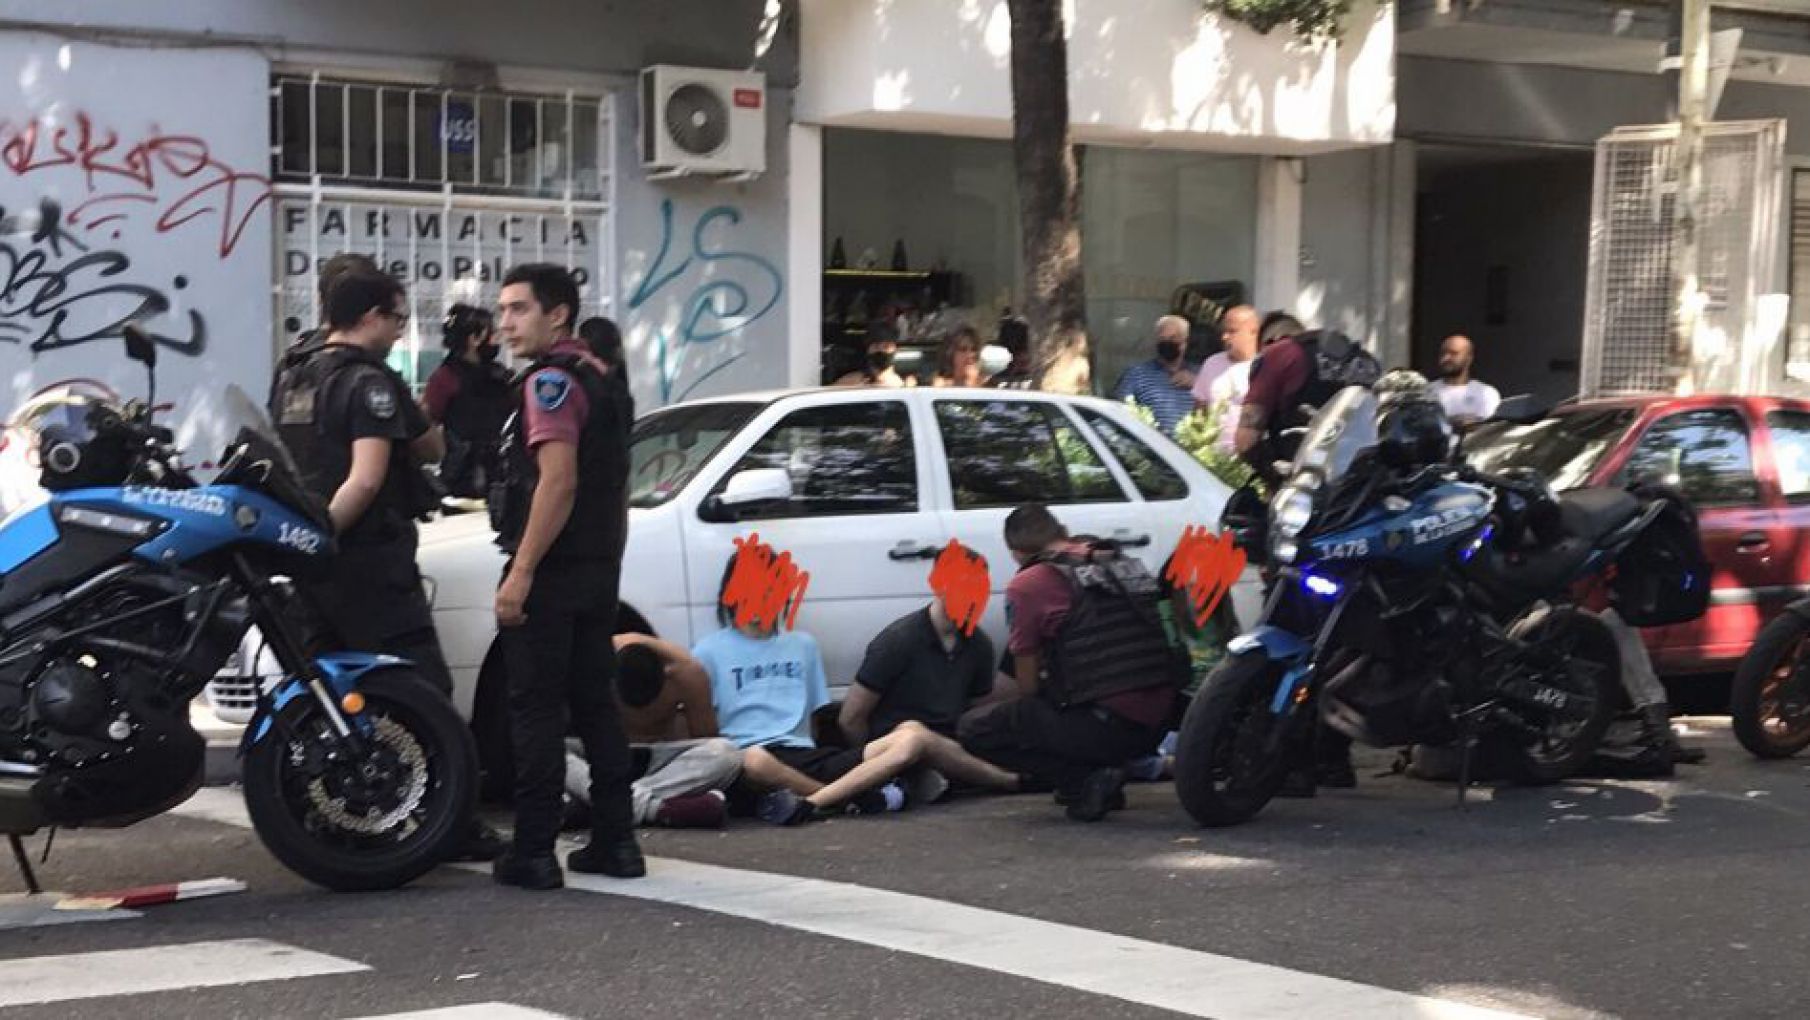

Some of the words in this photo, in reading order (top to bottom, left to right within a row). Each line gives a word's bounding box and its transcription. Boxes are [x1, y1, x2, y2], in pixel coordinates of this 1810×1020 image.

[285, 208, 589, 246] FARMACIA
[383, 251, 442, 285] iejo
[454, 255, 589, 287] Palo
[1319, 537, 1370, 560] 1478
